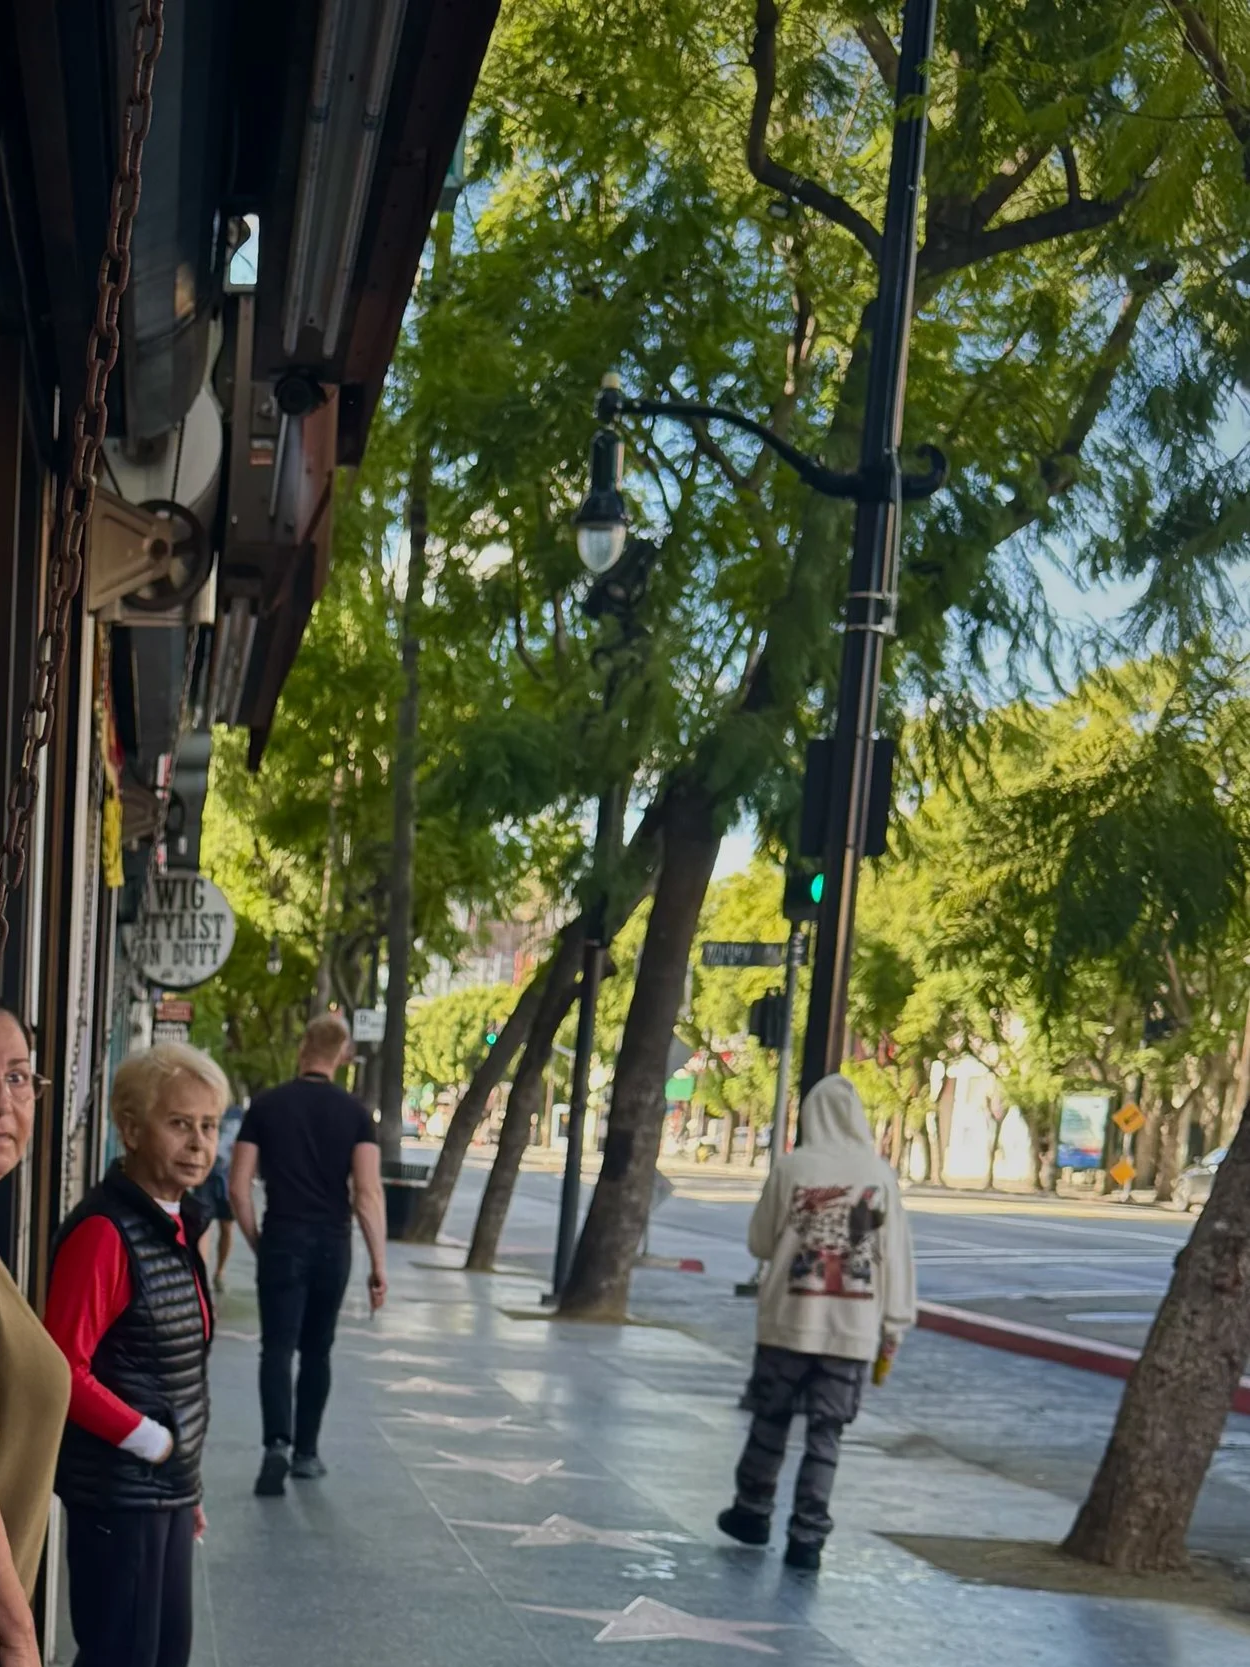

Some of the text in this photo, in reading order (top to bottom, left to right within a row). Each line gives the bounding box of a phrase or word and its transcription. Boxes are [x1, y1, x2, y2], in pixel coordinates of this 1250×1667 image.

[154, 878, 205, 910] WIG
[138, 912, 227, 941] STYLIST
[136, 943, 222, 966] ON DUTY
